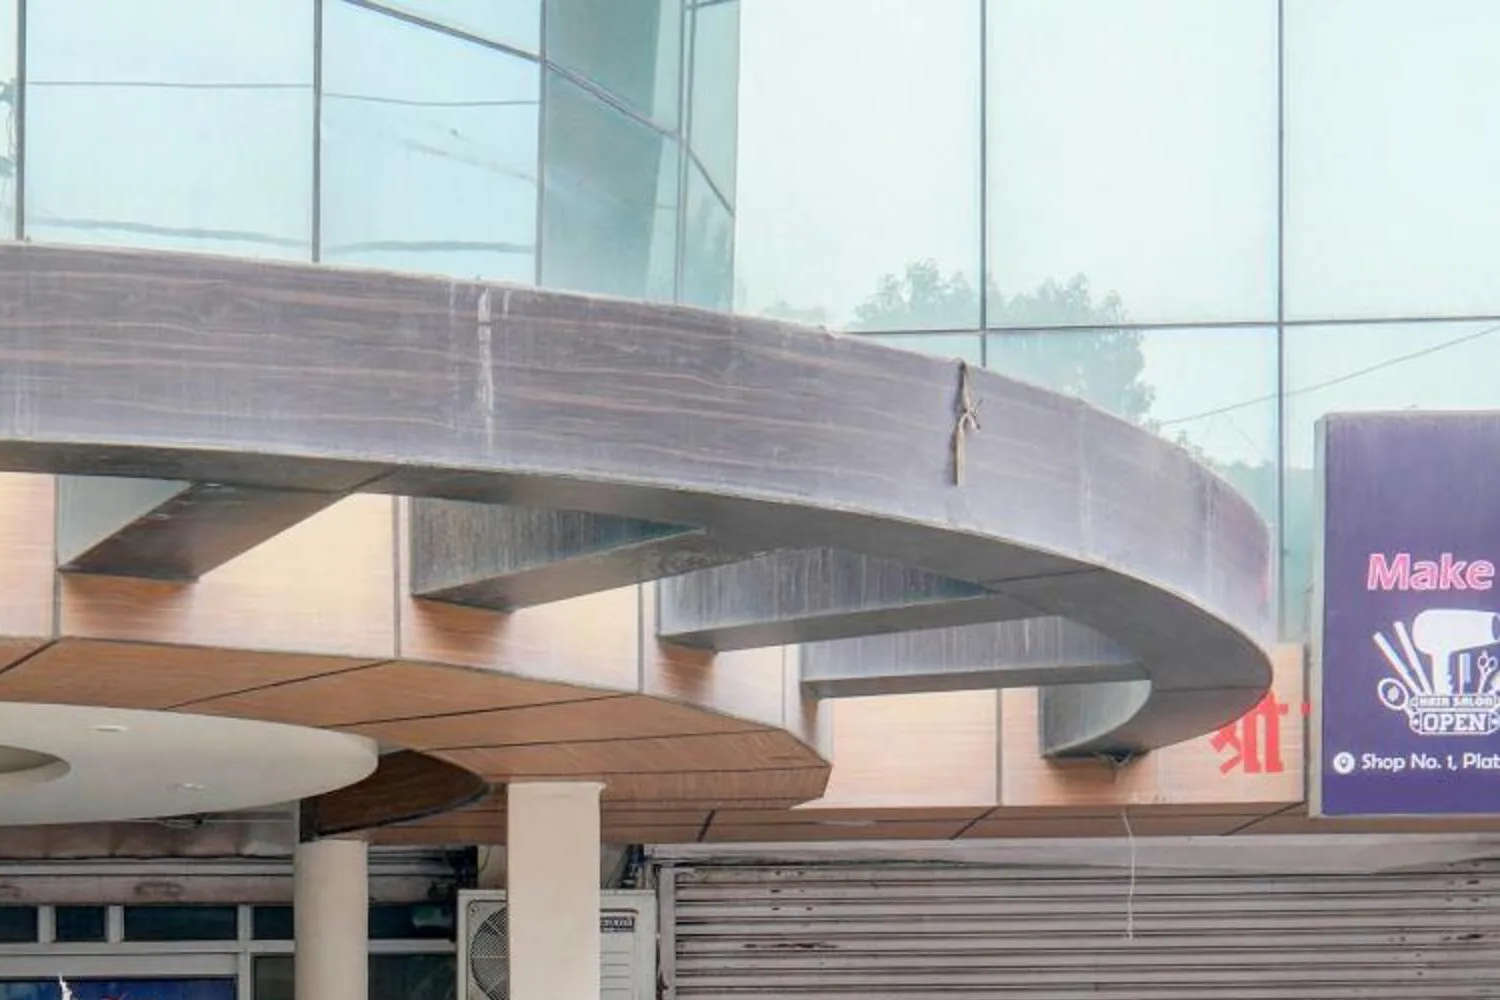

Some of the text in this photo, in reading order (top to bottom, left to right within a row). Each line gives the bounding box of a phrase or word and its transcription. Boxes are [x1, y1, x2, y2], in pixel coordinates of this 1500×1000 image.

[1367, 552, 1495, 591] Make
[1423, 713, 1486, 731] OPEN
[1362, 753, 1405, 773] Shop
[1411, 753, 1442, 769] No.
